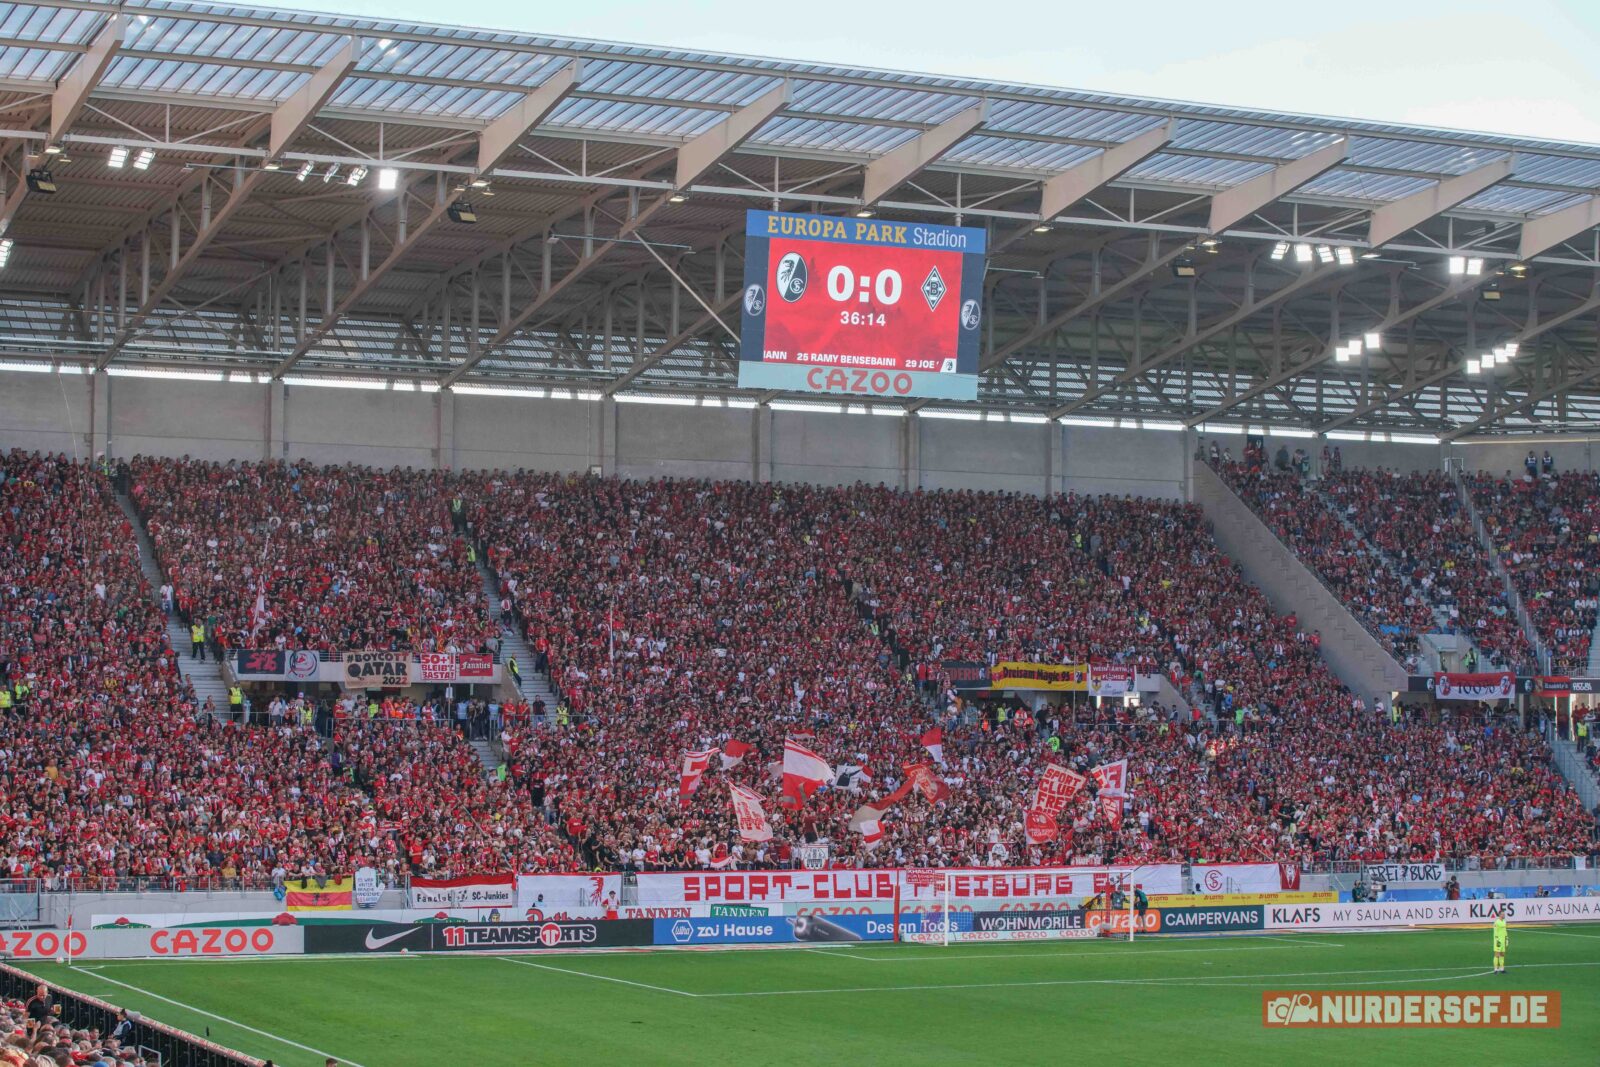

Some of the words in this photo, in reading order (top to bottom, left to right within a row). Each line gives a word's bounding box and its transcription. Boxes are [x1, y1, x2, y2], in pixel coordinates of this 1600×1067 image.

[767, 215, 848, 239] EUROPA
[856, 222, 907, 244] PARK
[913, 227, 967, 249] Stadion
[827, 265, 902, 305] 0:0
[840, 311, 886, 327] 36:14
[796, 353, 809, 361] 25
[811, 353, 839, 363] RAMY
[840, 355, 896, 367] BENSEBAINI
[905, 359, 917, 368] 29
[918, 360, 935, 369] JOE
[806, 367, 913, 394] CAZOO
[348, 662, 408, 678] QATAR
[383, 676, 408, 685] 2022
[1044, 768, 1081, 785] SPORT
[1039, 778, 1076, 797] CLUB
[1037, 792, 1072, 811] FRE
[472, 891, 509, 900] SC-Junkies
[684, 874, 894, 901] SPORT-CLUB
[625, 907, 693, 919] TANNEN
[713, 906, 766, 918] TANNEN
[1165, 911, 1259, 926] CAMPERVANS
[1273, 907, 1321, 924] KLAFS
[1333, 909, 1351, 921] MY
[1357, 906, 1401, 921] SAUNA
[1406, 904, 1433, 919] AND
[1438, 903, 1459, 918] SPA
[1470, 902, 1515, 918] KLAFS
[1526, 904, 1543, 915] MY
[1548, 903, 1590, 915] SAUNA
[724, 923, 773, 936] Hause
[866, 920, 916, 934] Desgn
[921, 919, 959, 933] Toos
[0, 931, 87, 956] ZOO
[150, 928, 274, 954] CAZOO
